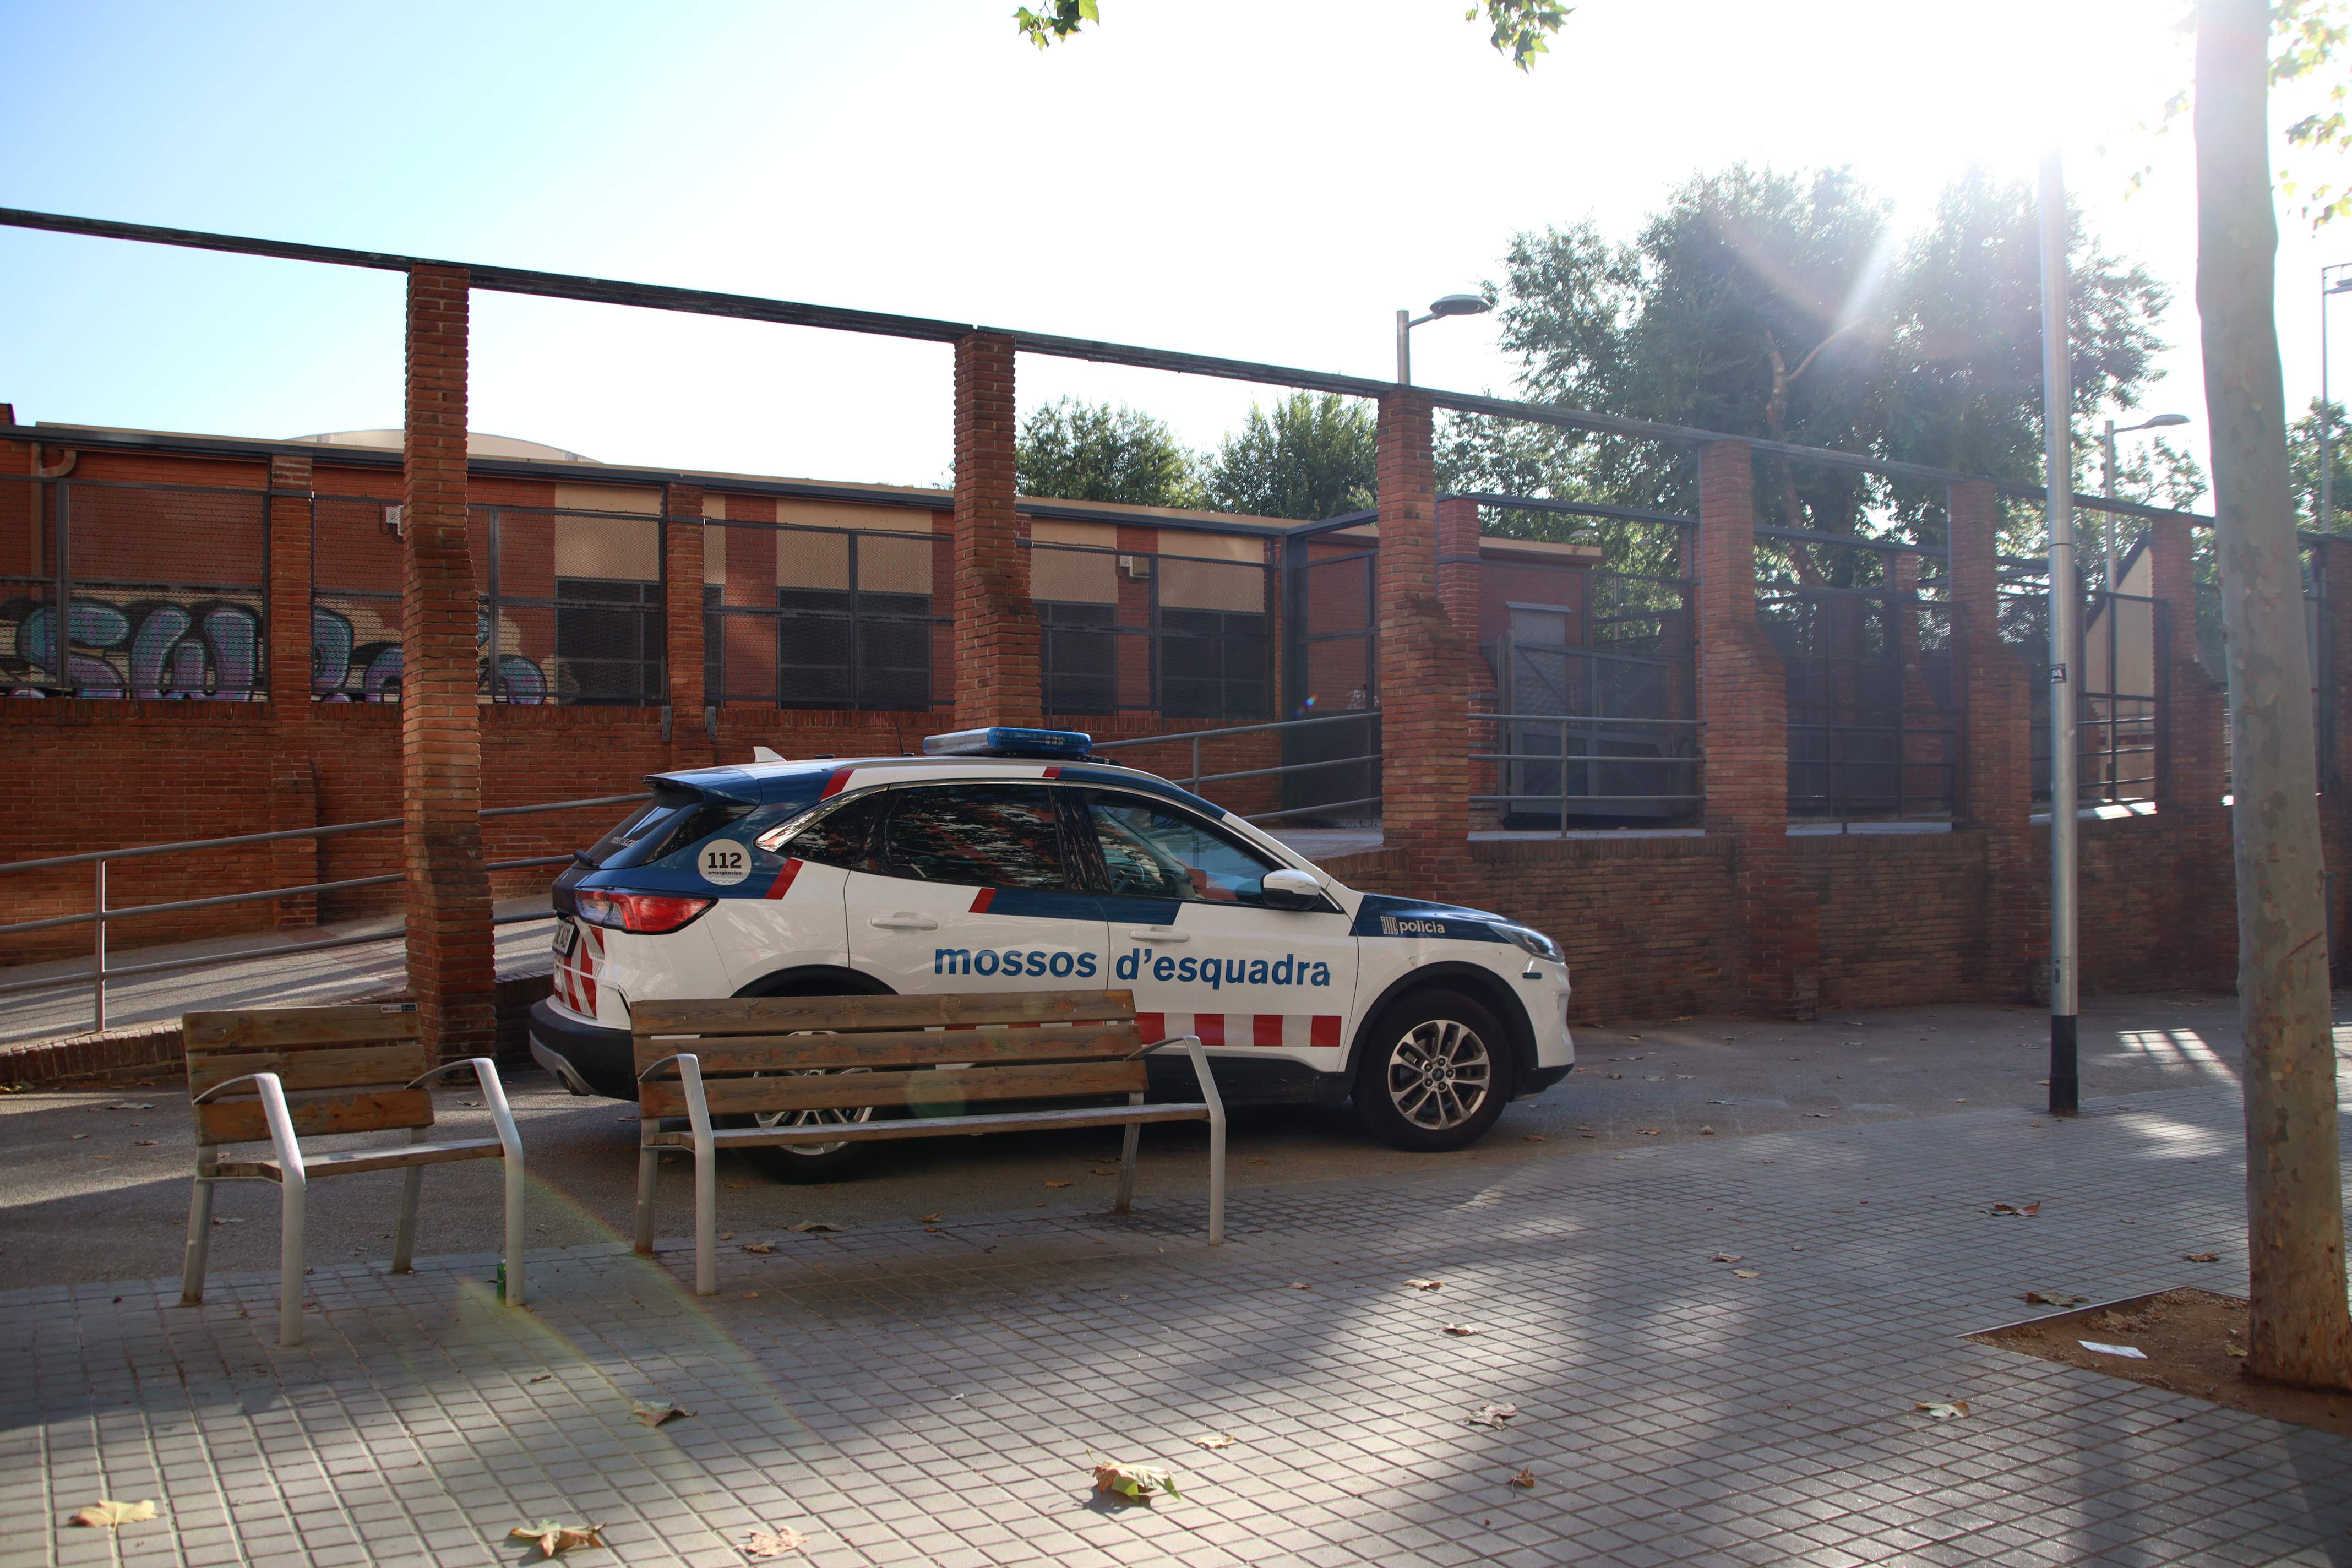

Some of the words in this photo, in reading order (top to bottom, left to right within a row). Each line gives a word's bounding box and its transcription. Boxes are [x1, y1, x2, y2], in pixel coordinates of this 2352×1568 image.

[708, 852, 742, 869] 112
[1399, 920, 1445, 934] policia
[935, 948, 1097, 978] mossos
[1115, 948, 1331, 990] d'esquadra
